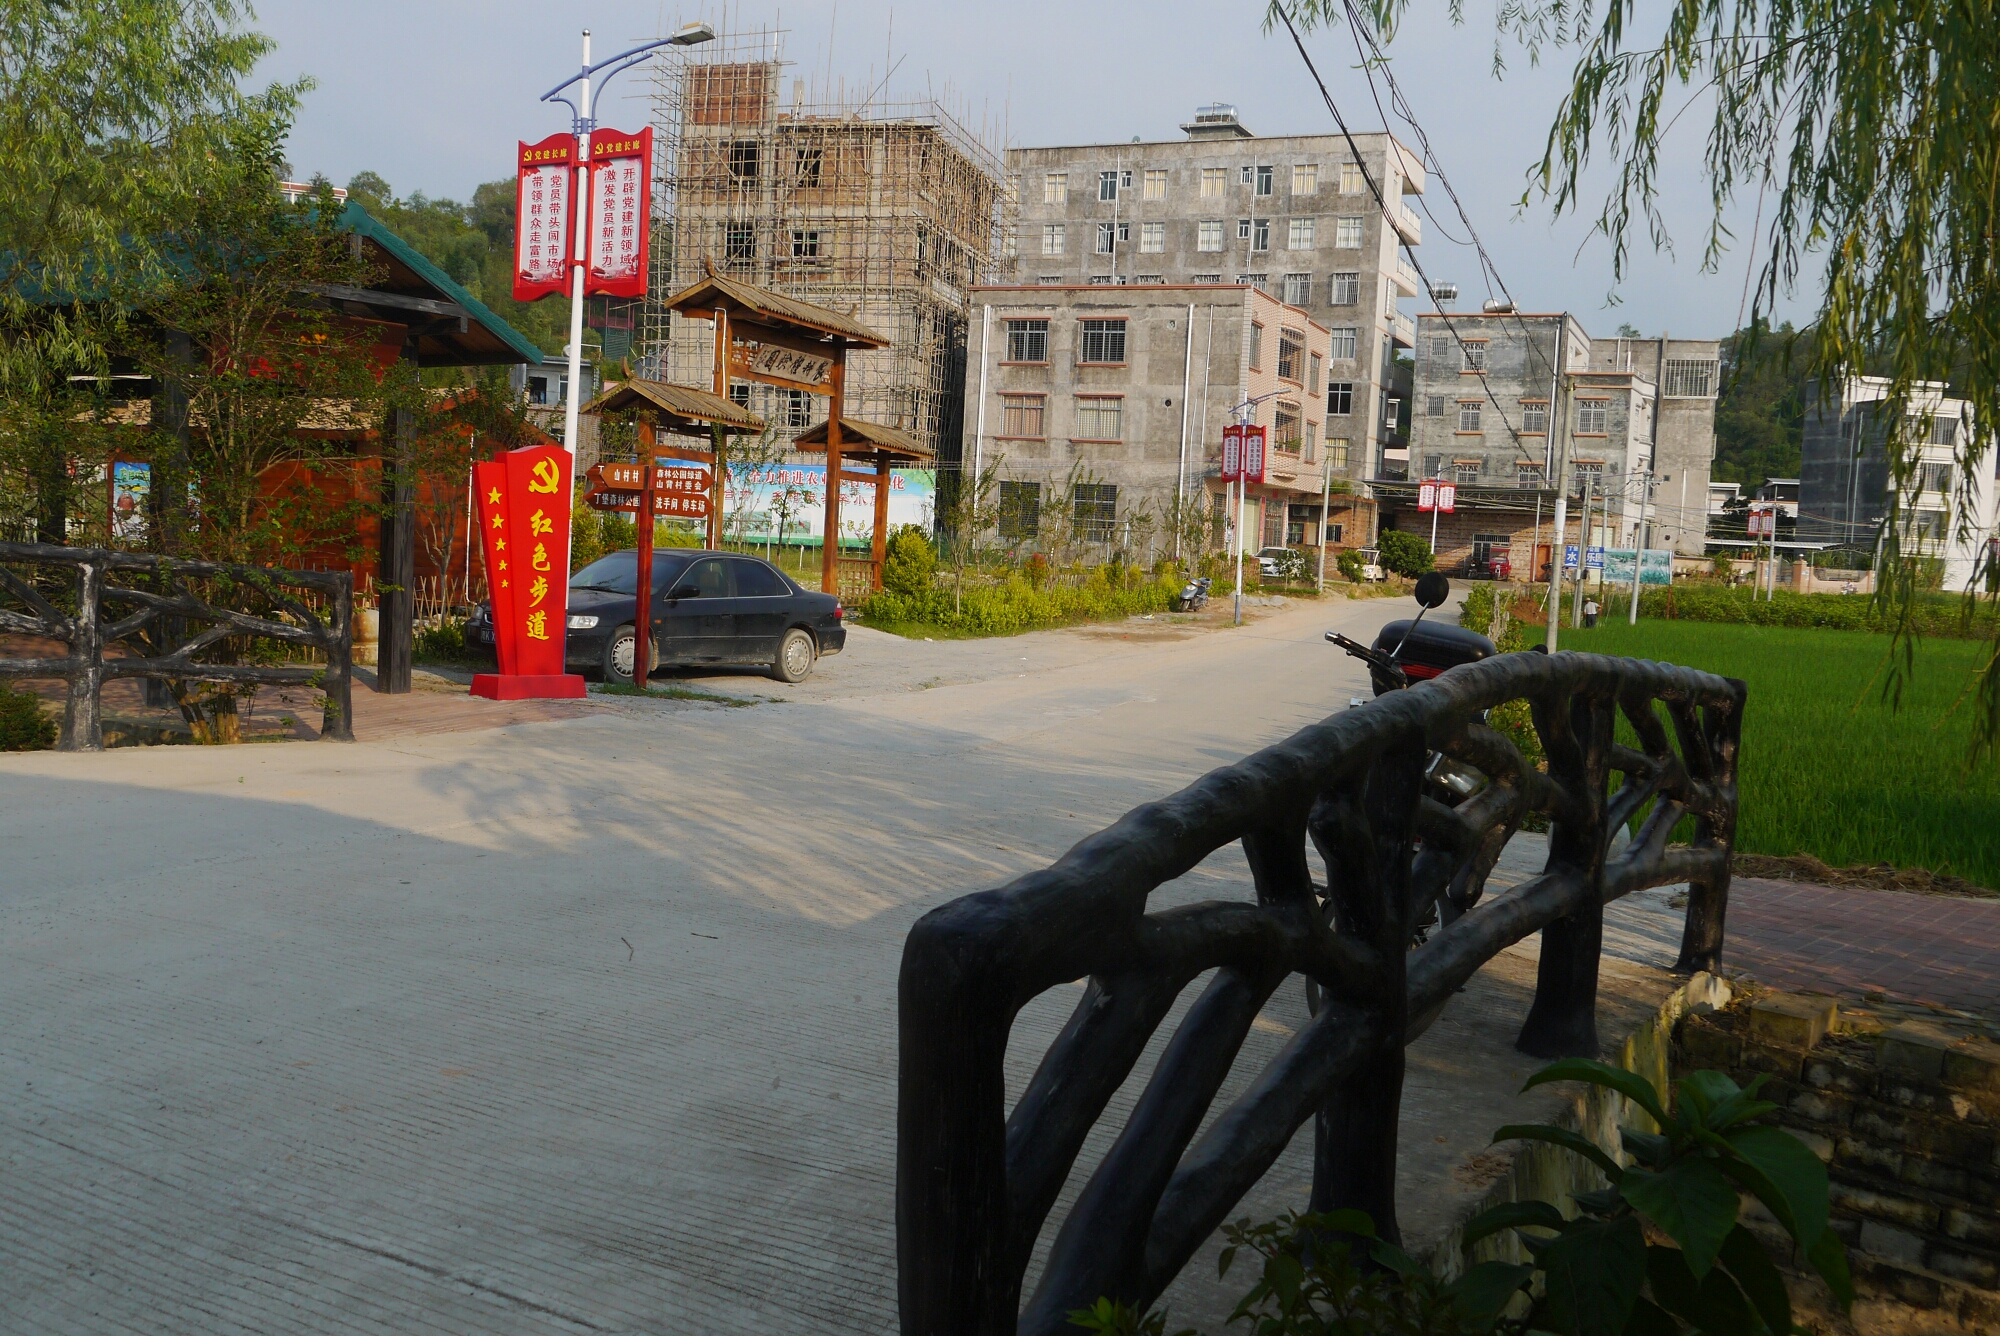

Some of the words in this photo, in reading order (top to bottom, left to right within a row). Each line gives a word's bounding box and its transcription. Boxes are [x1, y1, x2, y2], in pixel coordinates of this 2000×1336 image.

[534, 148, 568, 160] 党建长廊
[606, 140, 640, 153] 党建长廊
[528, 176, 544, 271] 带领群众走富路
[546, 174, 562, 269] 党员带头闯市场
[601, 169, 617, 268] 激发党员新活力
[620, 168, 636, 266] 开辟党建新领域
[656, 469, 702, 480] 森林公园绿道
[656, 479, 702, 491] 山背村委会
[594, 493, 641, 507] 丁堡森林公园
[655, 496, 678, 511] 洗手间
[682, 498, 706, 513] 停车场
[1566, 551, 1604, 563] 水乐园
[526, 508, 554, 641] 红色步道
